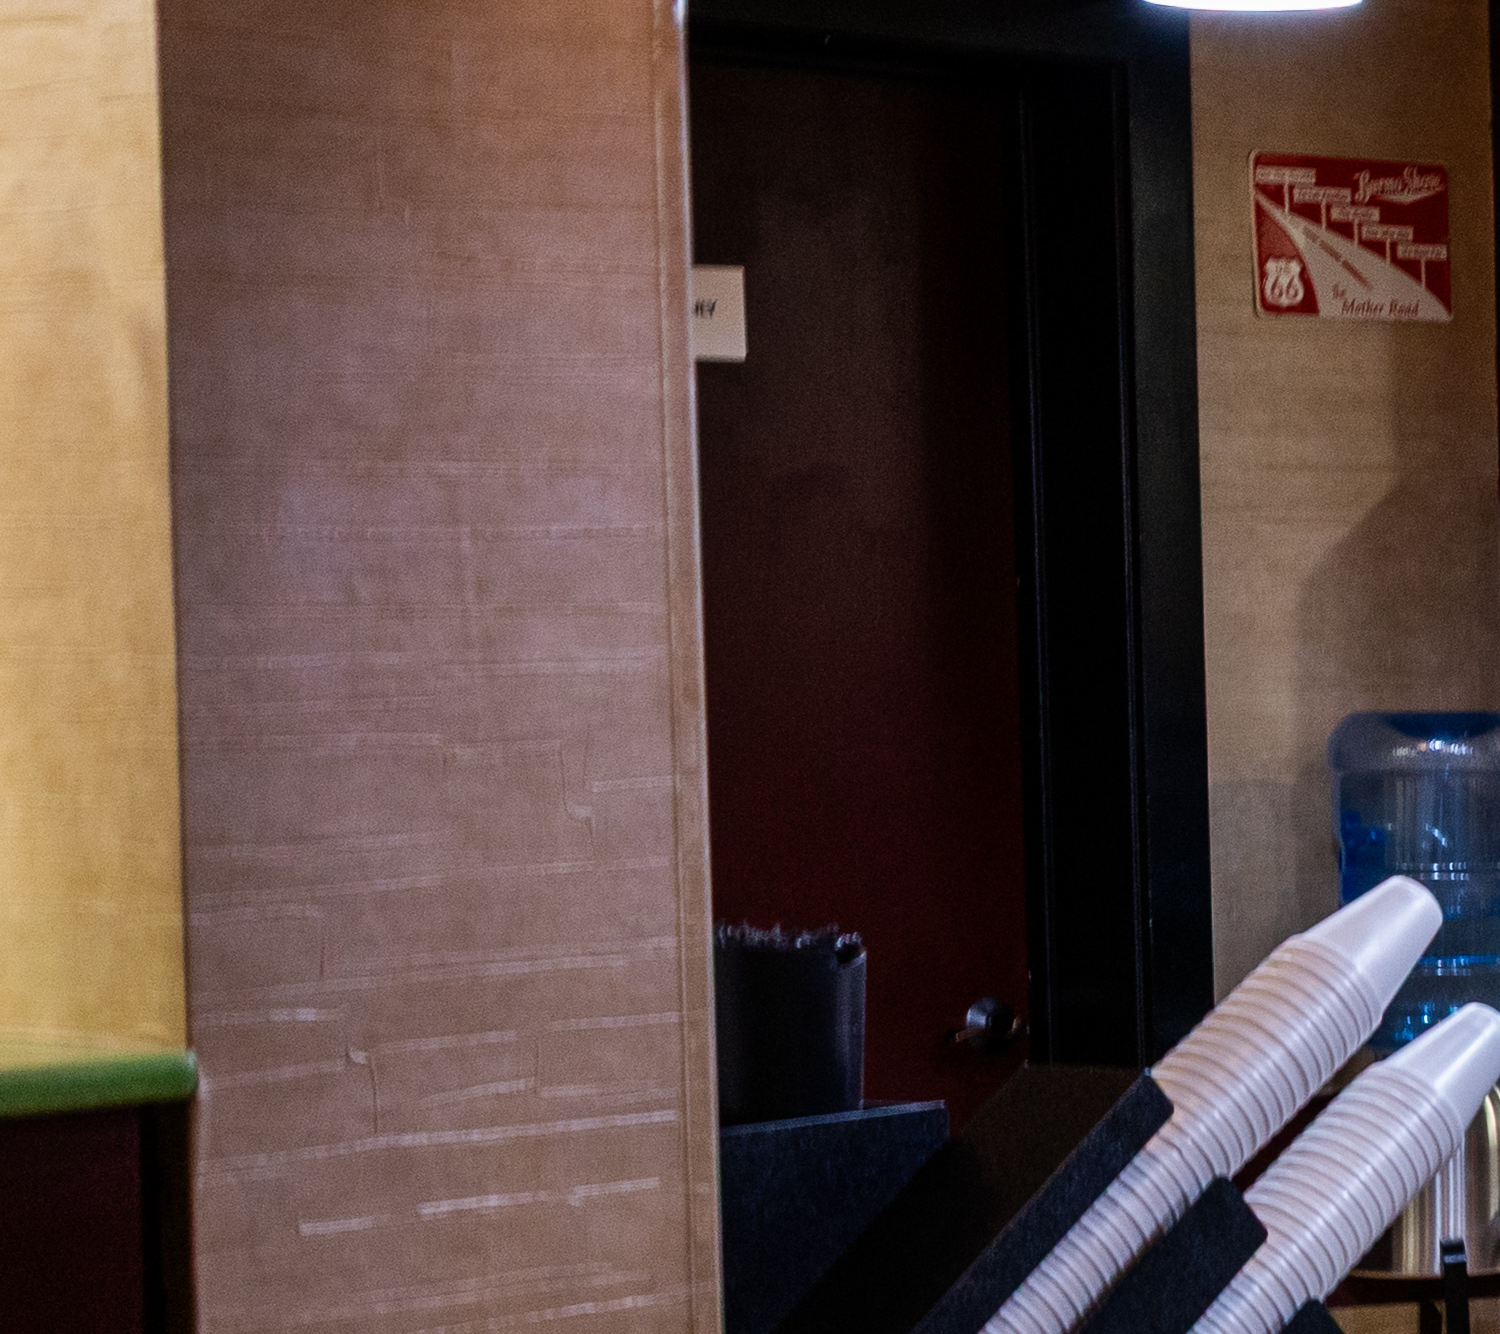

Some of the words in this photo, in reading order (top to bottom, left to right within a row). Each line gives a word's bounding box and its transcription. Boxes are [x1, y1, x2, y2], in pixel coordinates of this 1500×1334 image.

[1271, 275, 1299, 299] 66
[1342, 298, 1385, 317] Mother
[1389, 299, 1420, 318] Road
